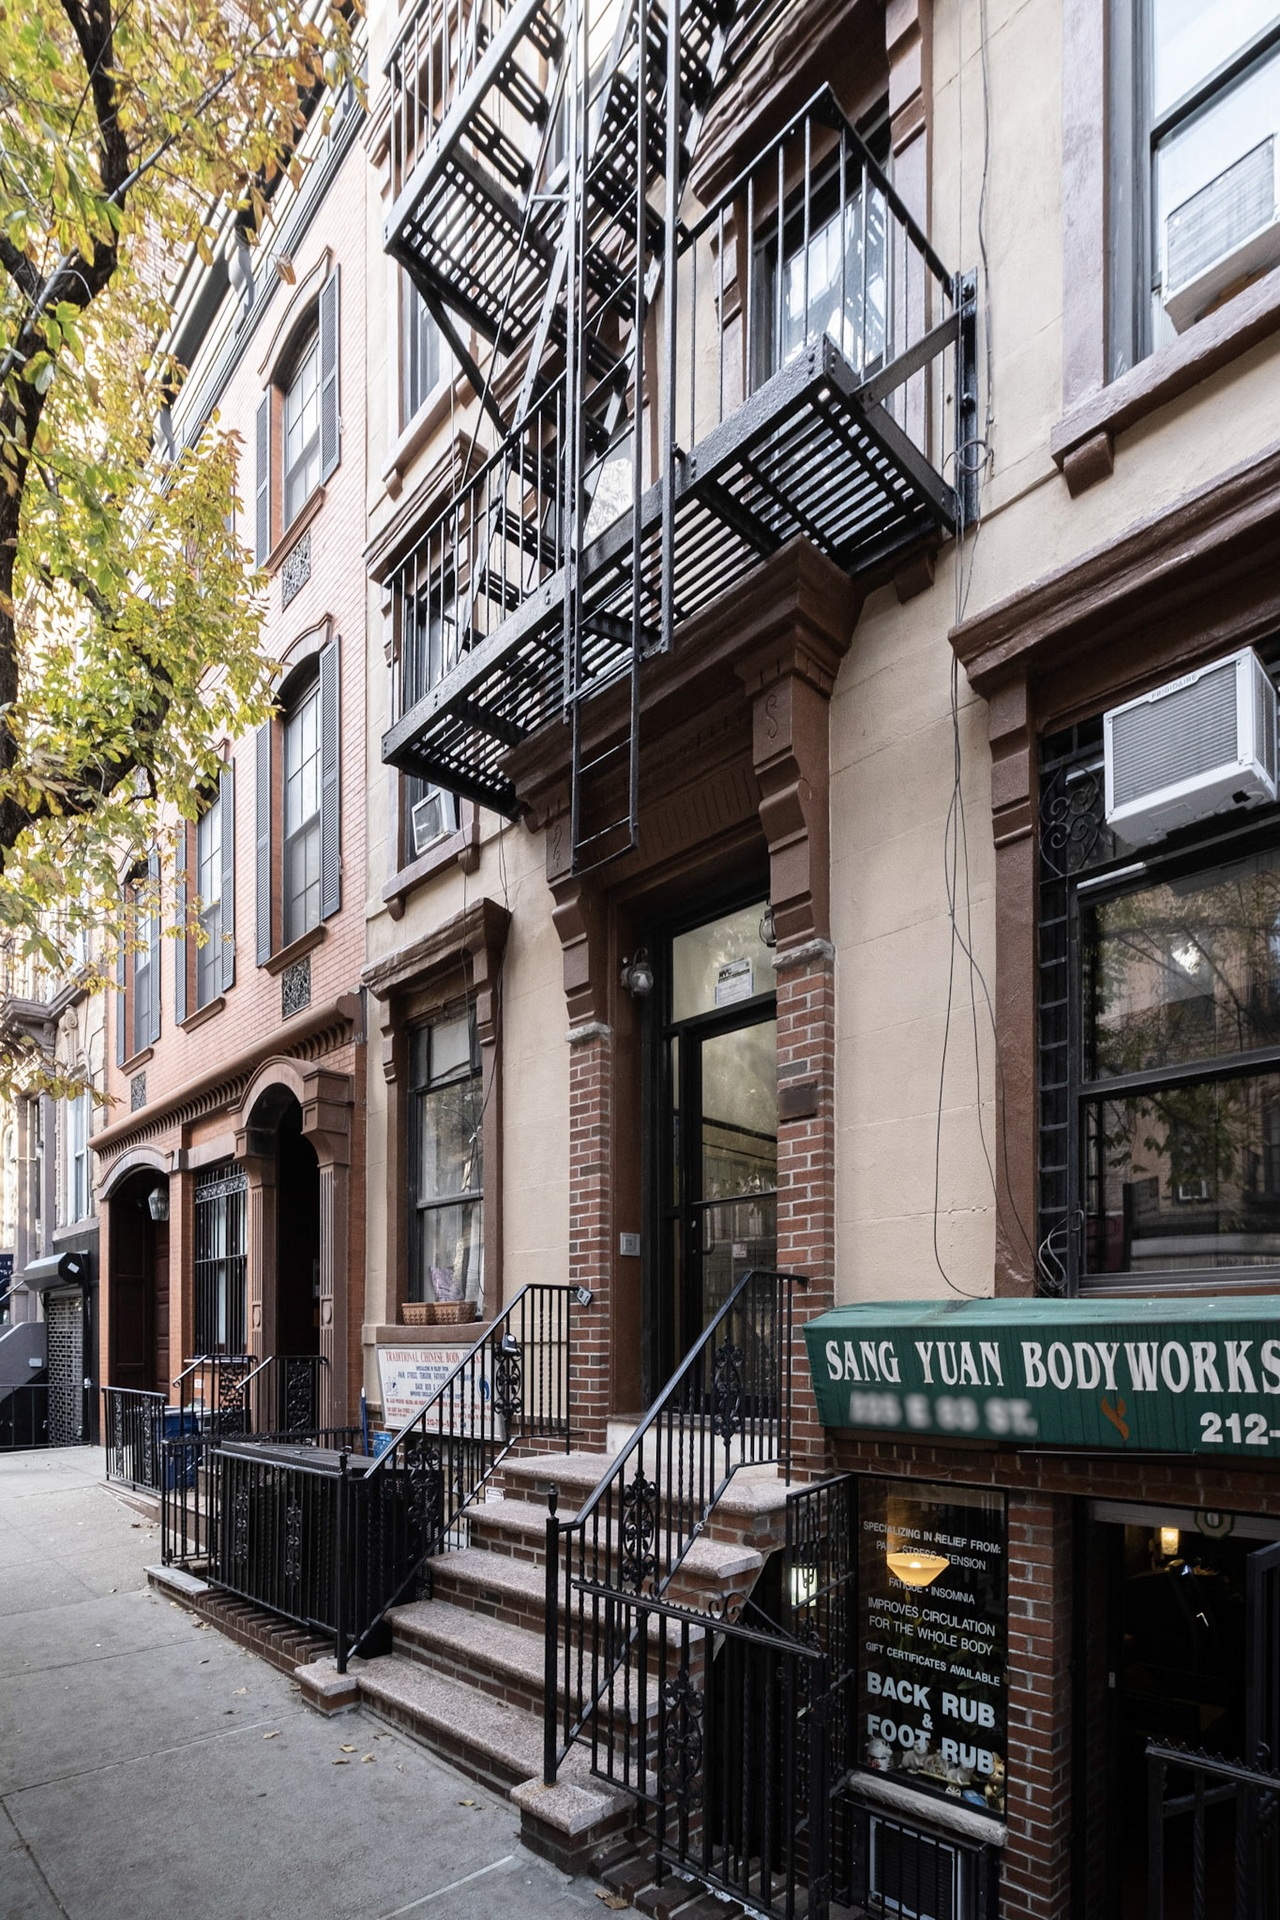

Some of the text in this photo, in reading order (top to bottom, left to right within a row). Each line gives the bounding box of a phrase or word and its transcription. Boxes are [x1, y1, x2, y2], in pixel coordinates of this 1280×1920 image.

[1151, 674, 1197, 699] FRIGIDAIRE
[420, 1352, 445, 1363] CHINESE
[825, 1340, 1280, 1395] SANG YUAN BODYWORKS
[863, 1521, 1001, 1554] SPECIALIZING IN RELIEF FROM:
[902, 1545, 937, 1561] STRESS
[945, 1553, 986, 1571] TENSION
[931, 1586, 975, 1605] INSOMNIA
[868, 1597, 996, 1637] IMPROVES CIRCULATION
[869, 1615, 993, 1656] FOR THE WHOLE BODY
[866, 1642, 1000, 1687] GIFT CERTIFICATES AVAILABLE
[867, 1671, 996, 1728] BACK RUB
[922, 1713, 934, 1730] &
[867, 1713, 995, 1775] FOOT RUB
